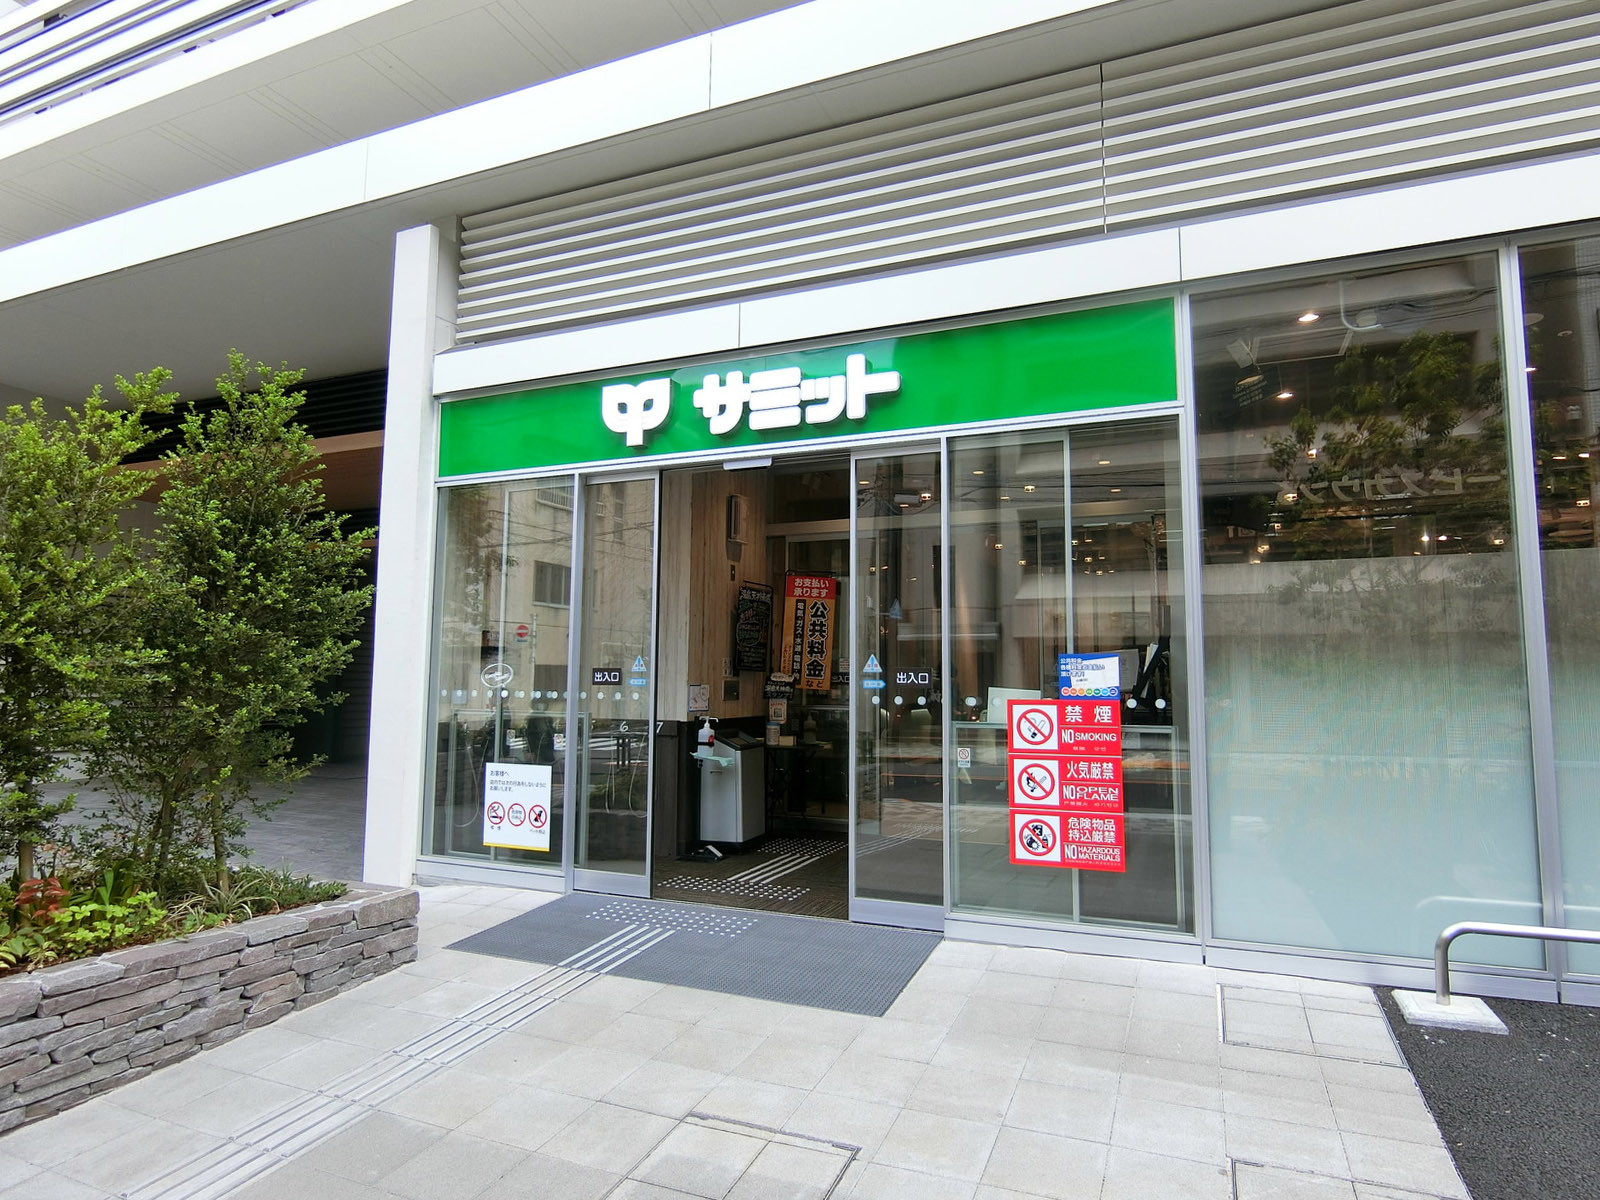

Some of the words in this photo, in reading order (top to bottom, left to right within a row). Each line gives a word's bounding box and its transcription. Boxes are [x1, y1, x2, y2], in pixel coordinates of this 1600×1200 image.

[693, 353, 901, 435] サミット
[794, 578, 829, 588] お支払い
[793, 588, 828, 598] 承ります
[805, 600, 830, 680] 公共料金
[594, 671, 619, 682] 出入口
[896, 672, 929, 684] 出入口
[805, 680, 824, 688] など
[620, 721, 628, 732] 6
[656, 722, 663, 733] 7
[1061, 729, 1074, 743] NO
[1075, 732, 1117, 742] SMOKING
[1066, 760, 1114, 780] 火気厳禁
[1063, 785, 1076, 800] NO
[1077, 785, 1119, 794] OPEN
[1077, 792, 1119, 801] FLAME
[1067, 816, 1116, 831] 危険物品
[1068, 828, 1116, 844] 持込厳禁
[1064, 844, 1077, 859] NO
[1078, 846, 1121, 855] HAZARDOUS
[1078, 853, 1121, 862] MATERIALS
